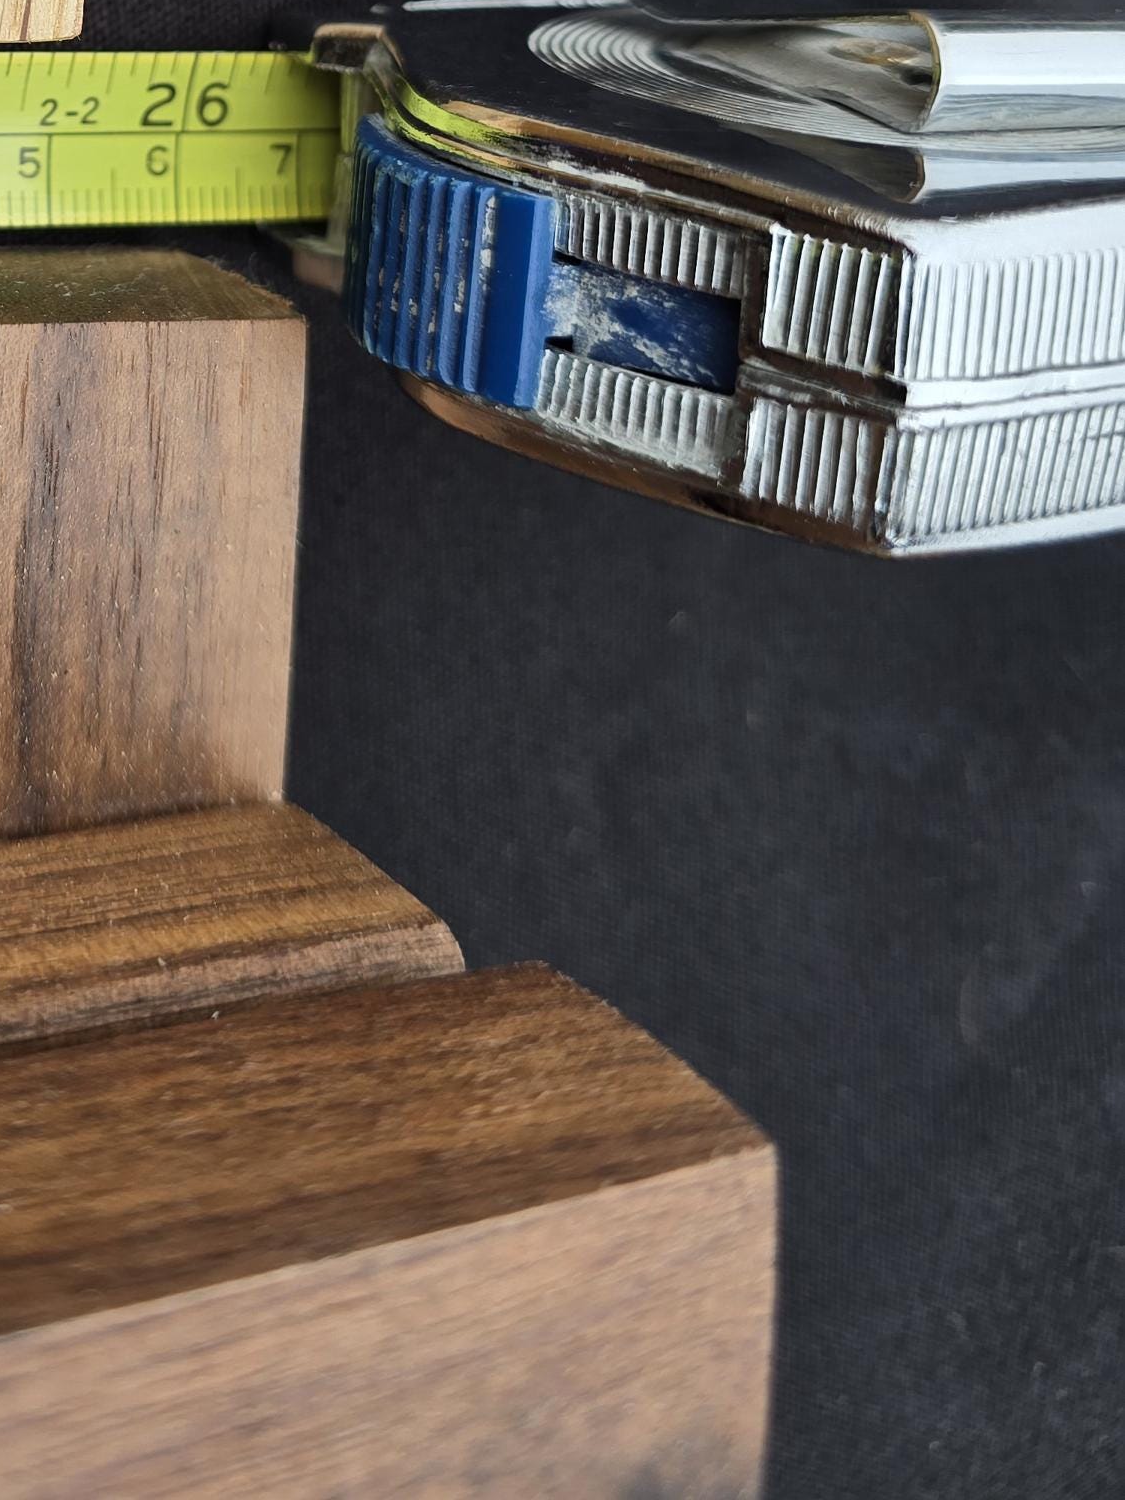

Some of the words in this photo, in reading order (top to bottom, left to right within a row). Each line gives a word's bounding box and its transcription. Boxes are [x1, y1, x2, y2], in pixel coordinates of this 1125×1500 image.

[40, 97, 101, 127] 2-2
[18, 146, 42, 178] 5
[145, 146, 170, 176] 6
[270, 143, 293, 174] 7
